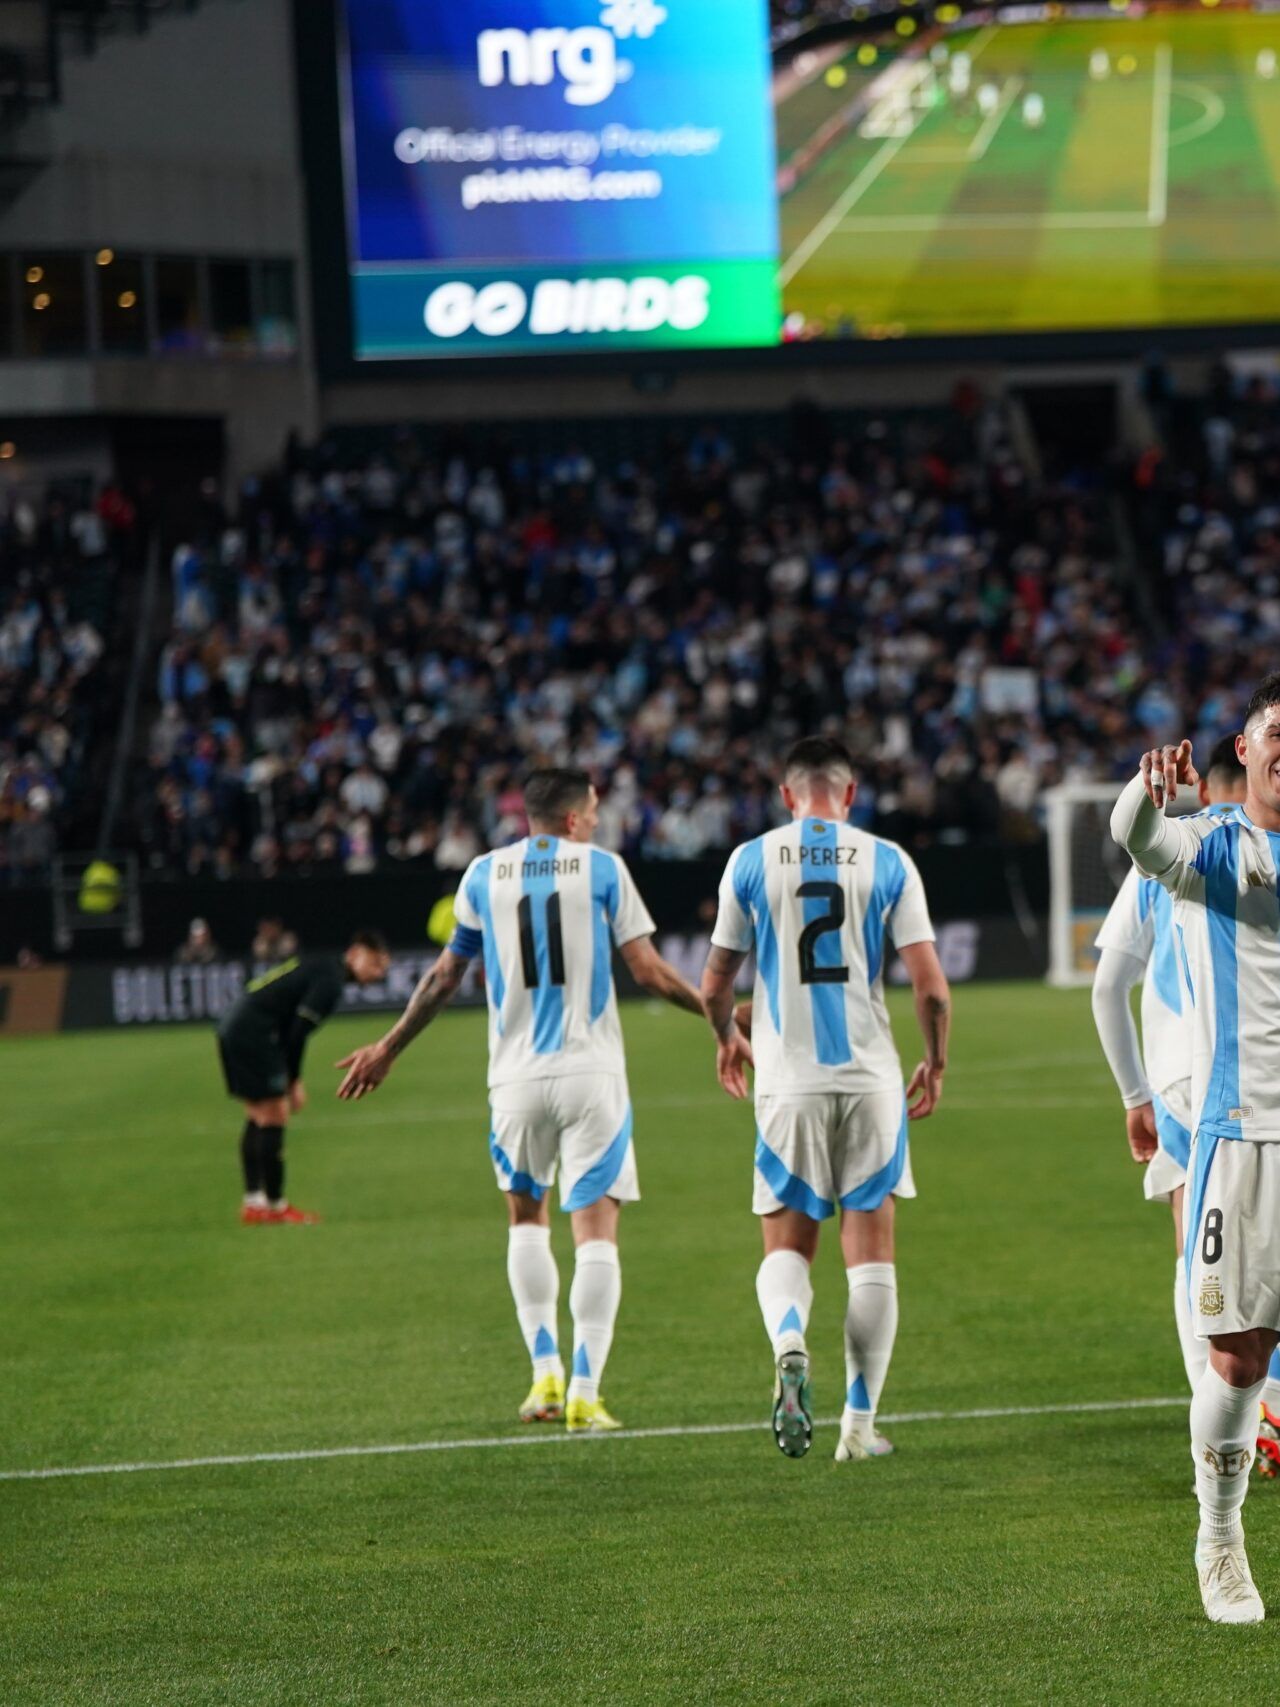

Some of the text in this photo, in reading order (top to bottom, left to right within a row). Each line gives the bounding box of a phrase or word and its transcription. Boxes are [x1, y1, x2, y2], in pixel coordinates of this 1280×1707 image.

[478, 27, 617, 106] nrg
[394, 127, 497, 163] Official
[501, 125, 600, 166] Energy
[424, 276, 711, 337] GO BIRDS
[497, 858, 581, 880] DI MARIA
[518, 891, 566, 989] 11
[796, 881, 849, 984] 2
[1201, 1208, 1223, 1265] 8
